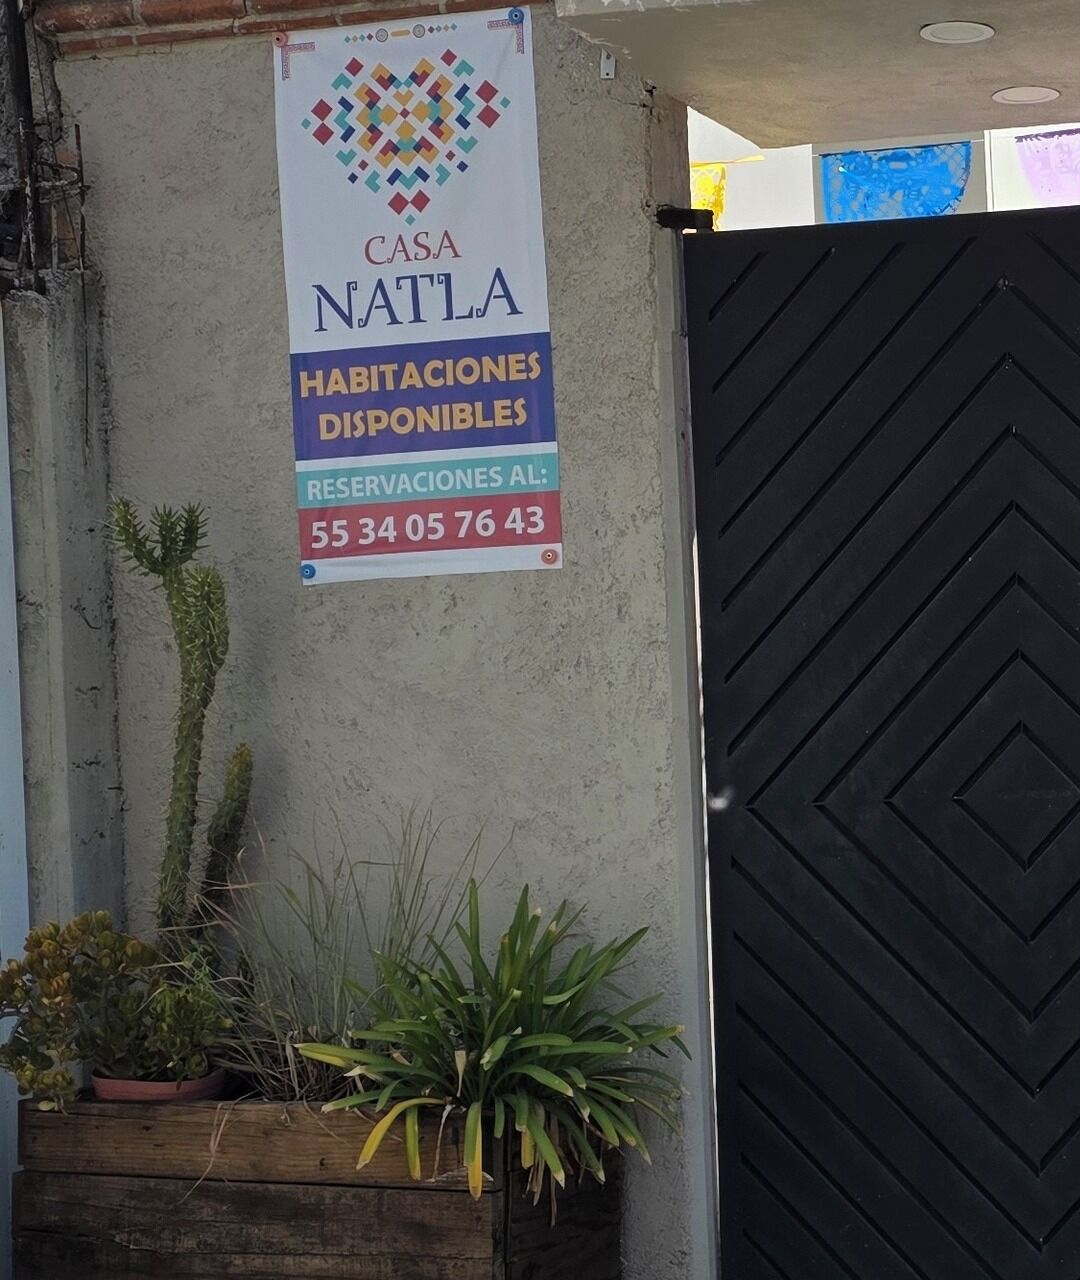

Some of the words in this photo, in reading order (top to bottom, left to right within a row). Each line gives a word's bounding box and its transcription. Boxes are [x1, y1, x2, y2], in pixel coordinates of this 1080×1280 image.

[364, 229, 462, 265] CASA
[312, 267, 523, 332] NATLA
[299, 351, 541, 398] HABITACIONES
[319, 397, 527, 440] DISPONIBLES
[307, 467, 503, 501] RESERVACIONES
[510, 464, 547, 486] AL:
[311, 520, 349, 549] 55
[358, 516, 397, 545] 34
[405, 512, 445, 542] 05
[454, 508, 496, 538] 76
[504, 506, 545, 535] 43
